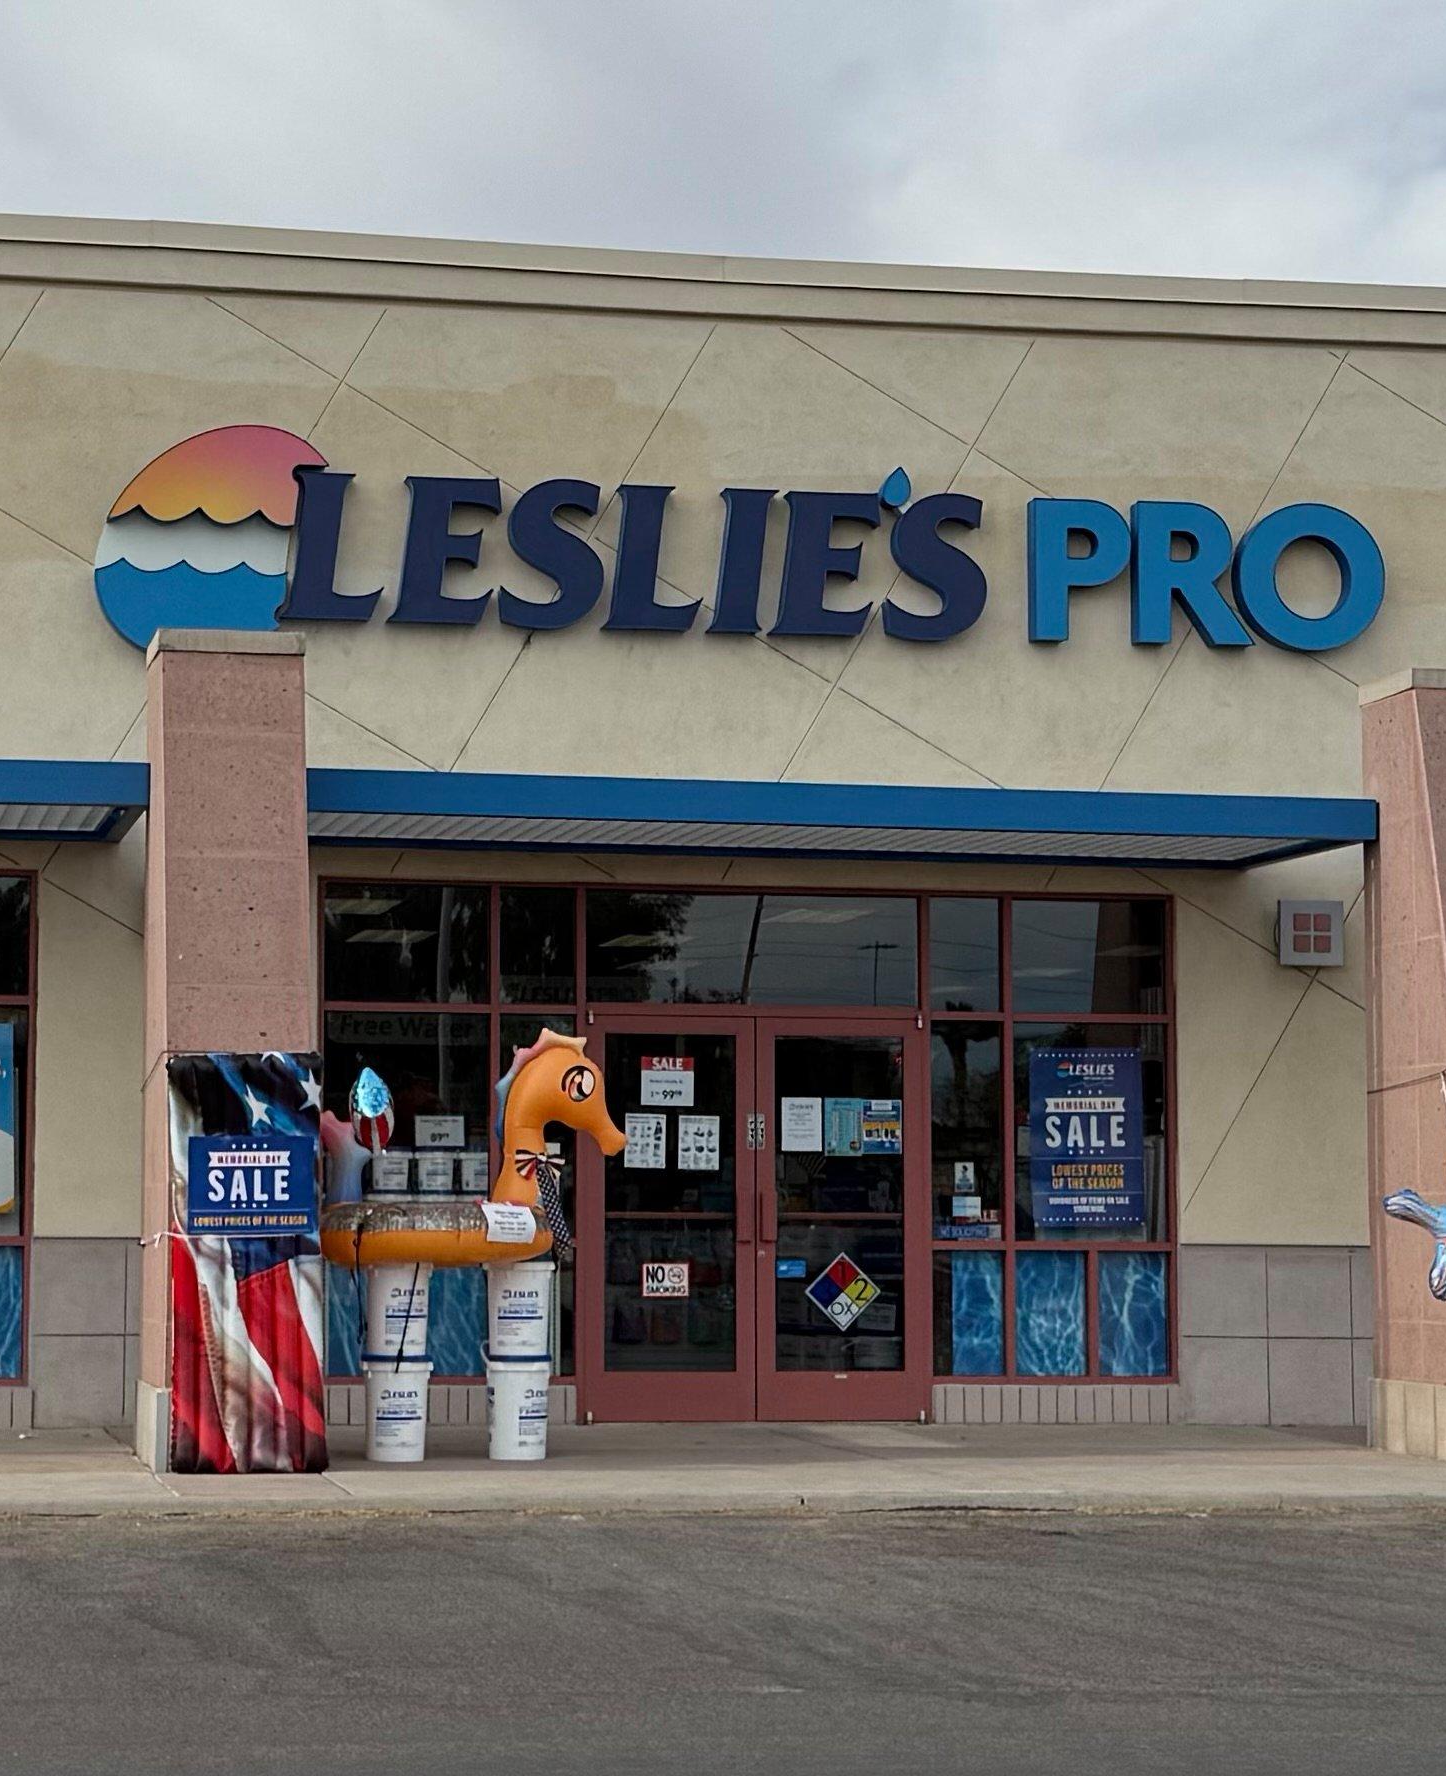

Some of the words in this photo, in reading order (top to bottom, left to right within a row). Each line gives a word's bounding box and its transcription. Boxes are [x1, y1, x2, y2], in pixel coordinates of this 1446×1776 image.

[278, 463, 989, 643] LESLIE'S
[1026, 496, 1387, 652] PRO
[398, 1016, 474, 1039] Waer
[651, 1057, 683, 1070] SALE
[1055, 1101, 1097, 1110] MEMORIAL
[1101, 1101, 1116, 1110] DAY
[1045, 1115, 1126, 1148] SALE
[218, 1155, 261, 1164] MEMORIAL
[266, 1155, 281, 1164] DAY
[1051, 1164, 1088, 1176] LOWEST
[1091, 1164, 1124, 1176] PRICES
[208, 1169, 290, 1202] SALE
[1052, 1178, 1064, 1189] OF
[1067, 1177, 1084, 1189] THE
[1088, 1177, 1124, 1189] SEASON
[194, 1216, 223, 1227] LOWEST
[224, 1216, 251, 1226] PRICES
[253, 1216, 262, 1225] OF
[264, 1216, 278, 1225] THE
[280, 1215, 307, 1225] SEASON
[646, 1265, 665, 1283] NO
[646, 1285, 686, 1294] SMOKING
[854, 1278, 868, 1301] 2
[831, 1302, 855, 1316] OX
